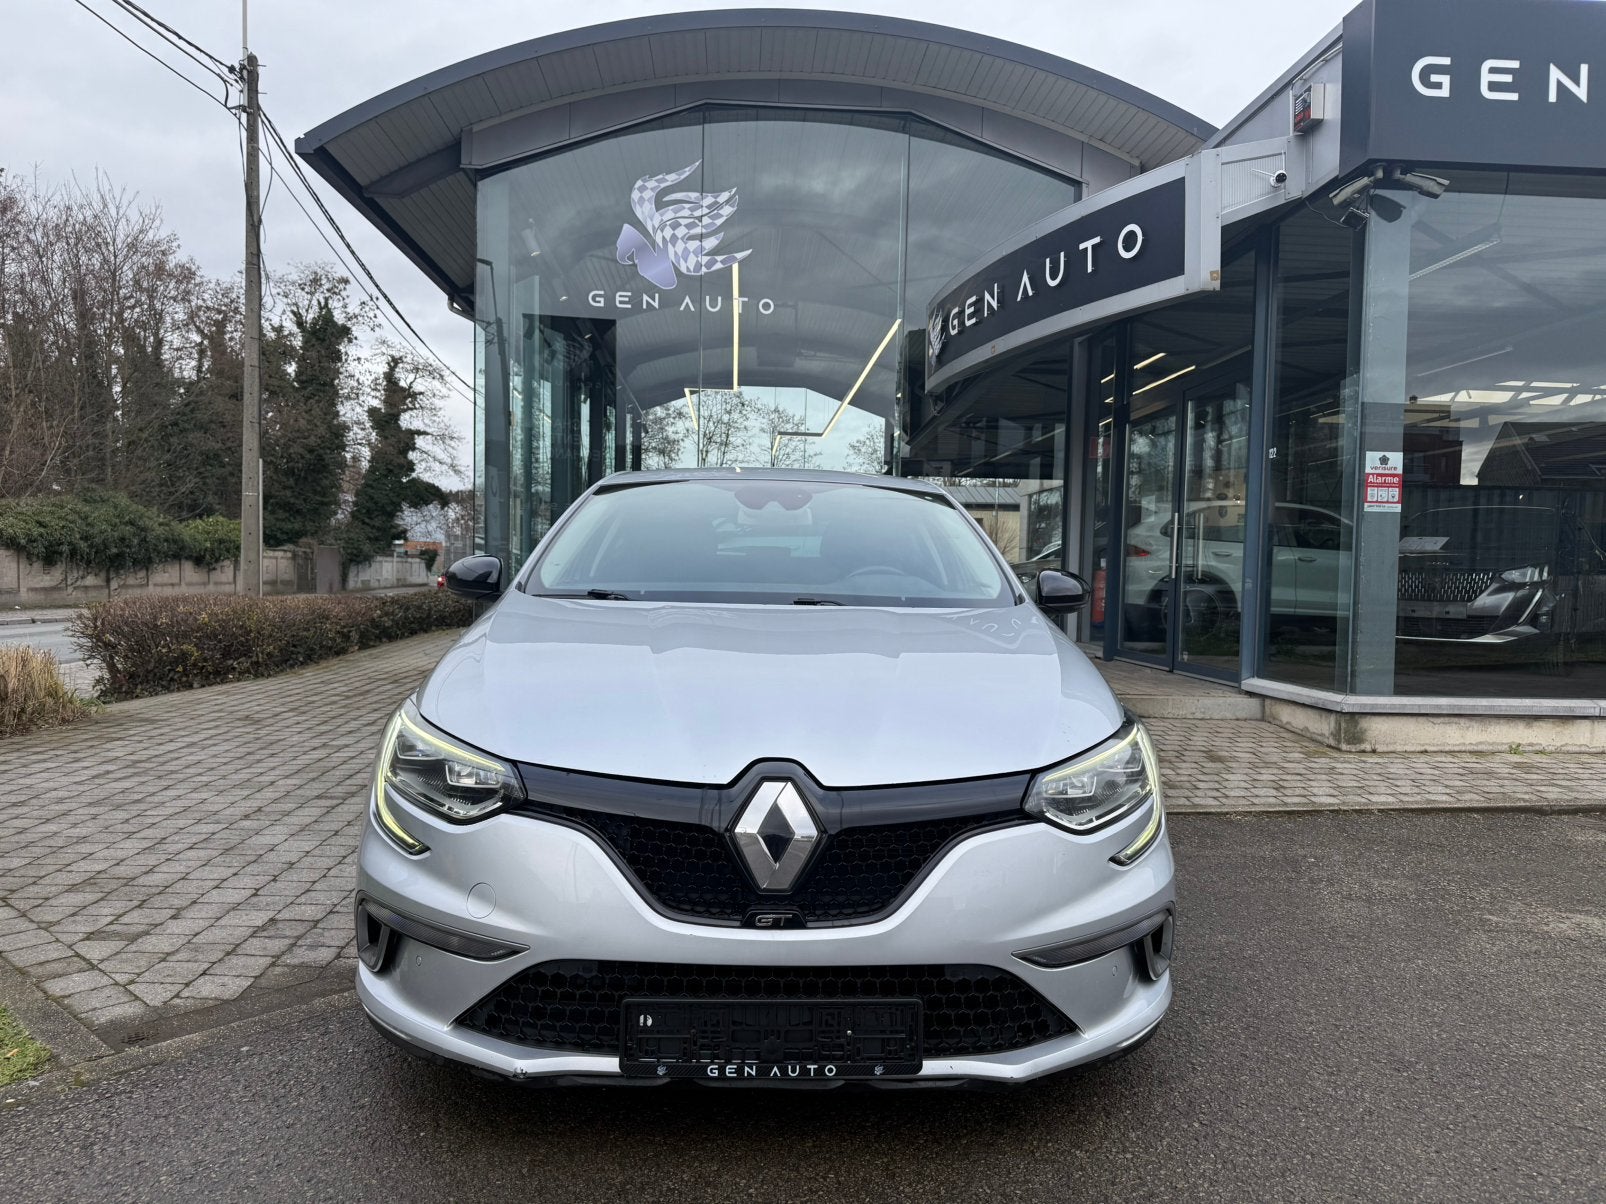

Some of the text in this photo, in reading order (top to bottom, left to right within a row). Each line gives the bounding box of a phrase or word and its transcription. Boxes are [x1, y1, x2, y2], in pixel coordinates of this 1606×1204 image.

[1411, 56, 1589, 104] GEN
[948, 223, 1144, 336] GEN AUTO
[587, 290, 775, 315] GEN AUTO
[1367, 474, 1399, 484] Alarme
[755, 914, 793, 927] GT
[707, 1064, 837, 1077] GEN AUTO
